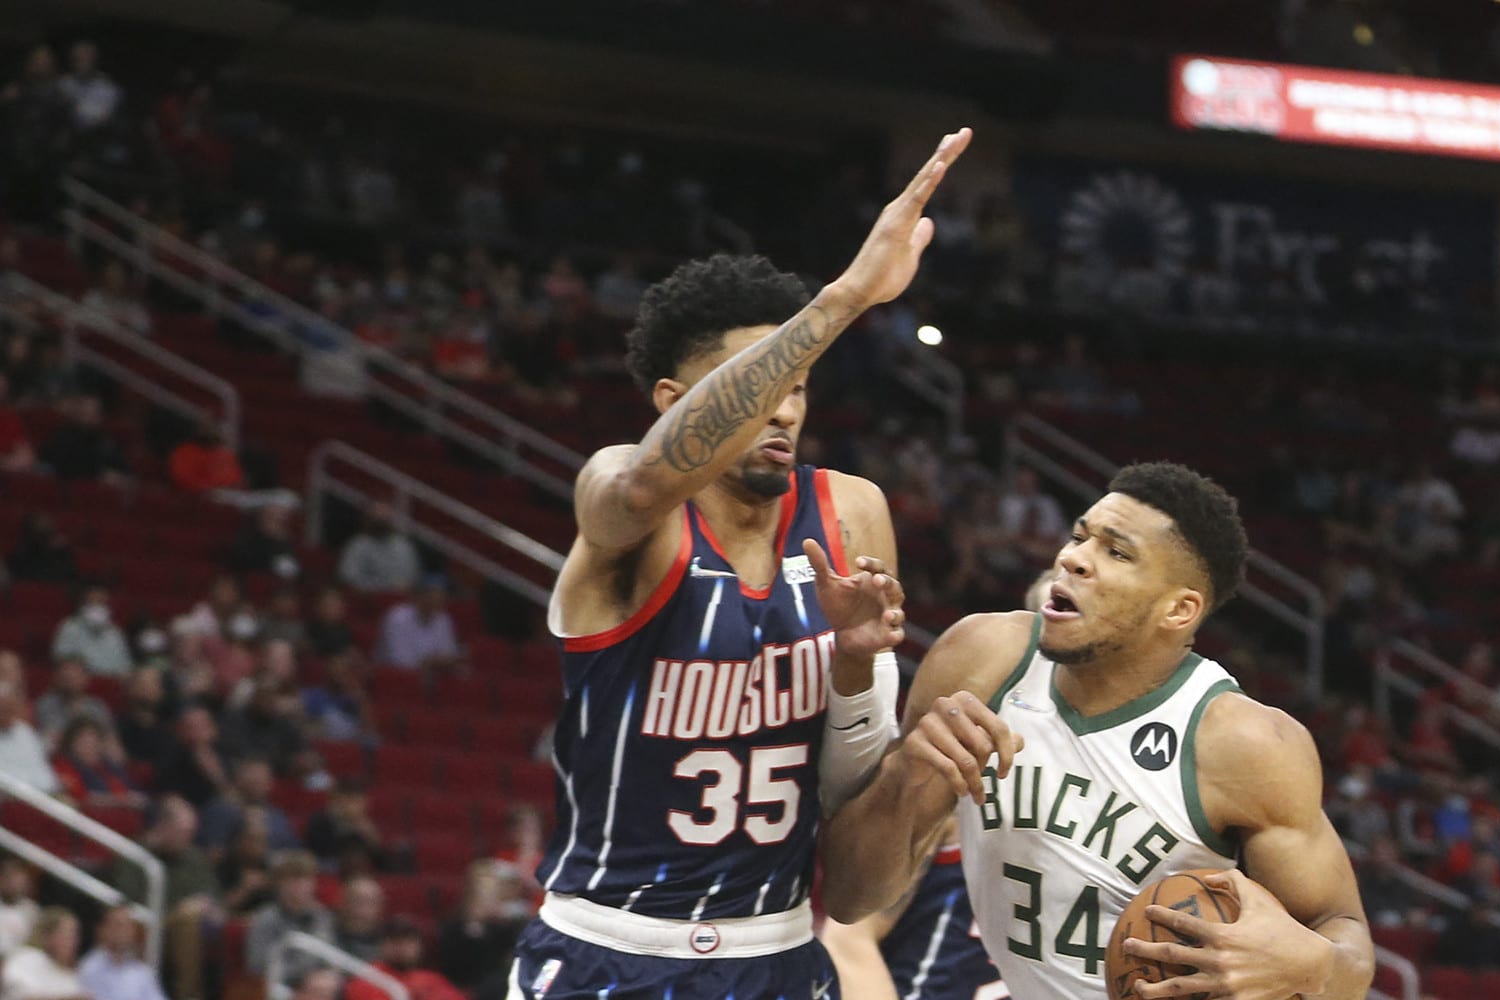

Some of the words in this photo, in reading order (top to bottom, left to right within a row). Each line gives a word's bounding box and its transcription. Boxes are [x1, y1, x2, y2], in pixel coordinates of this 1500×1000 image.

[667, 744, 809, 847] 35
[981, 764, 1180, 886] BUCKS
[1003, 862, 1106, 976] 34
